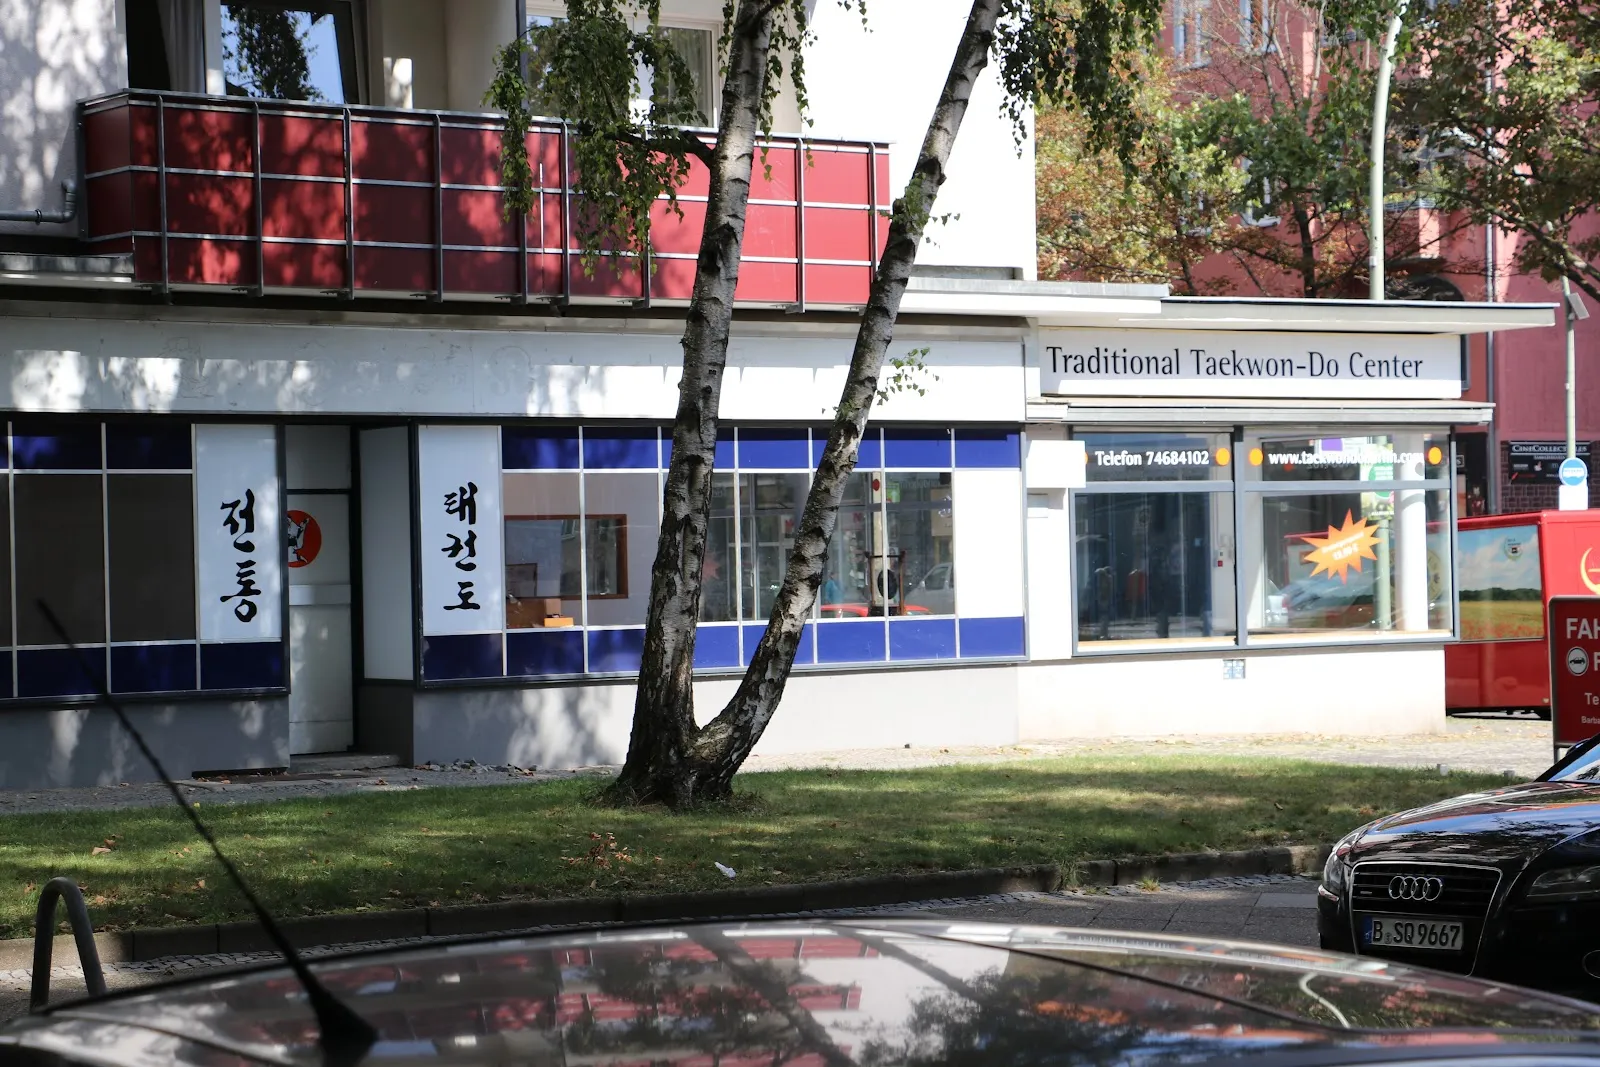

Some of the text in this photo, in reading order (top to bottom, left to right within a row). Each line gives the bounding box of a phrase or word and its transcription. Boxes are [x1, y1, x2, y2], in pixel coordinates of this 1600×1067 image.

[1045, 346, 1424, 378] Traditional Taekwon-Do Center
[1094, 450, 1210, 466] Telefon 74684102
[219, 488, 262, 623] 전통
[440, 481, 481, 611] 태권도
[1372, 919, 1461, 947] B SQ 9667
